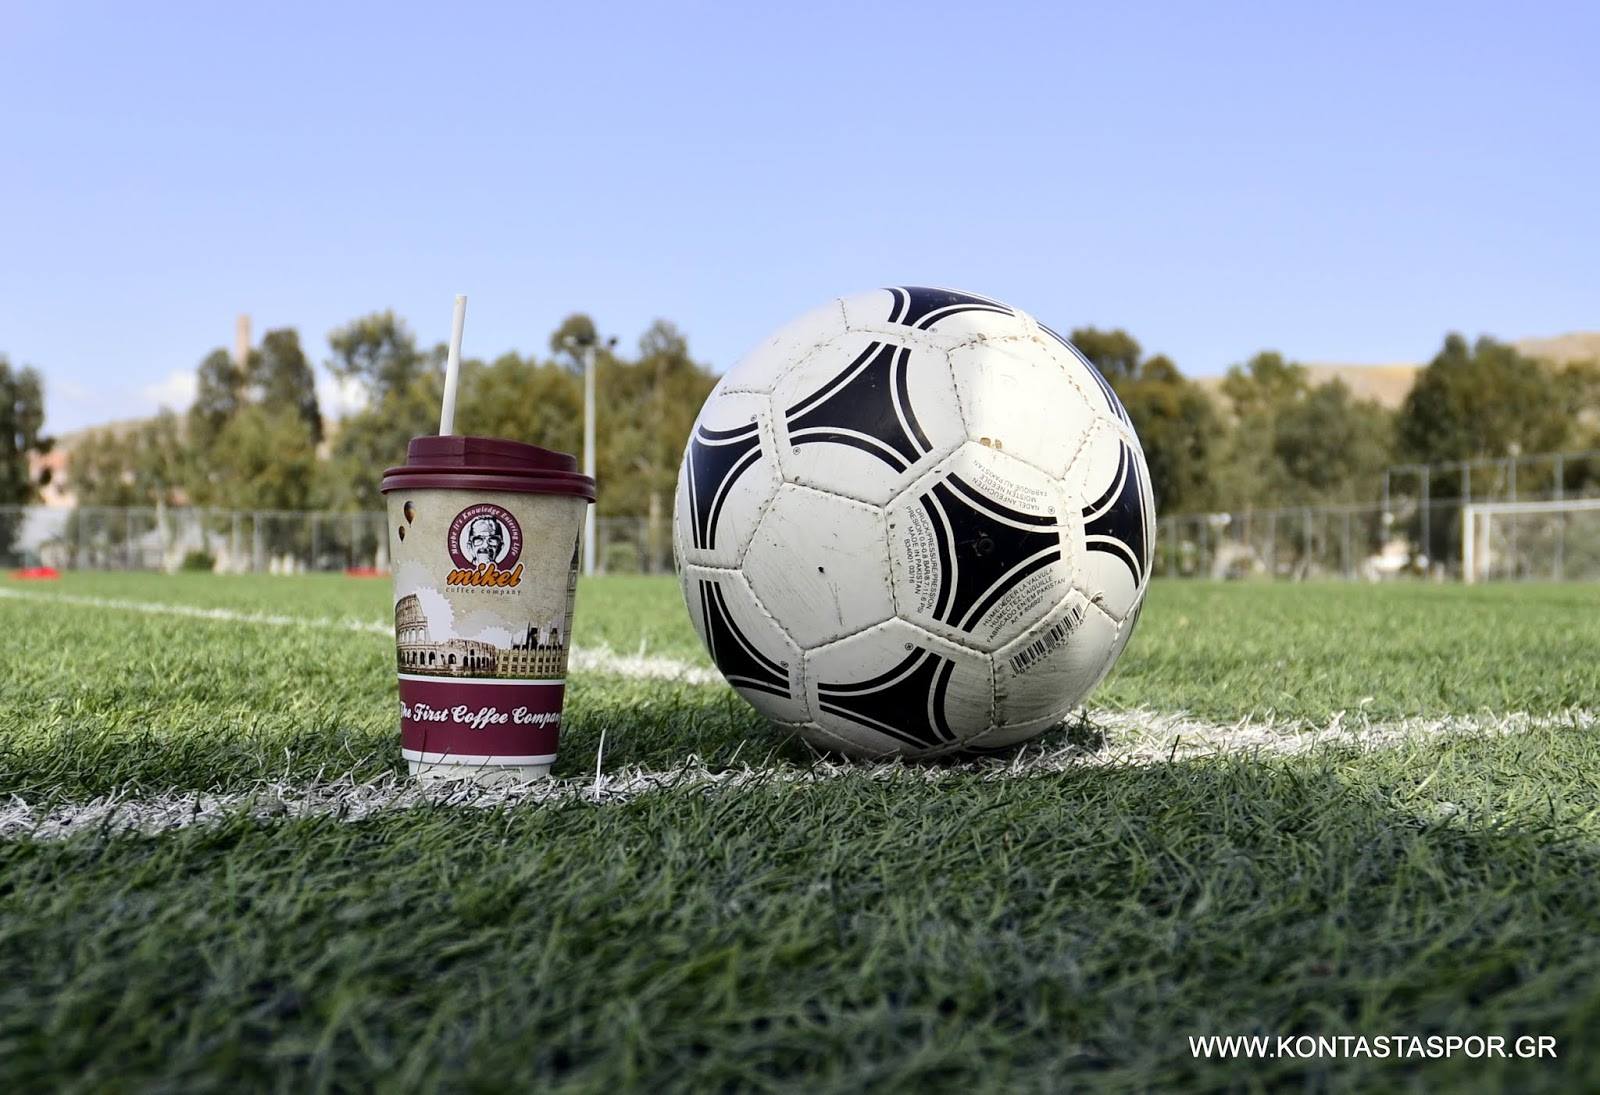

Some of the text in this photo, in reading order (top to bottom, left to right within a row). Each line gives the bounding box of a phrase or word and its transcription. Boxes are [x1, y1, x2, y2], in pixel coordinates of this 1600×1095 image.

[972, 478, 1016, 505] ANFEUCHTEN
[463, 506, 500, 519] Knowledge
[512, 542, 520, 556] Life
[908, 526, 919, 547] MADE
[914, 549, 920, 557] IN
[447, 563, 524, 587] mikel
[987, 609, 1017, 642] FABRICADO
[1036, 577, 1065, 595] PAKISTAN
[413, 703, 449, 722] First
[451, 705, 509, 729] Coffee
